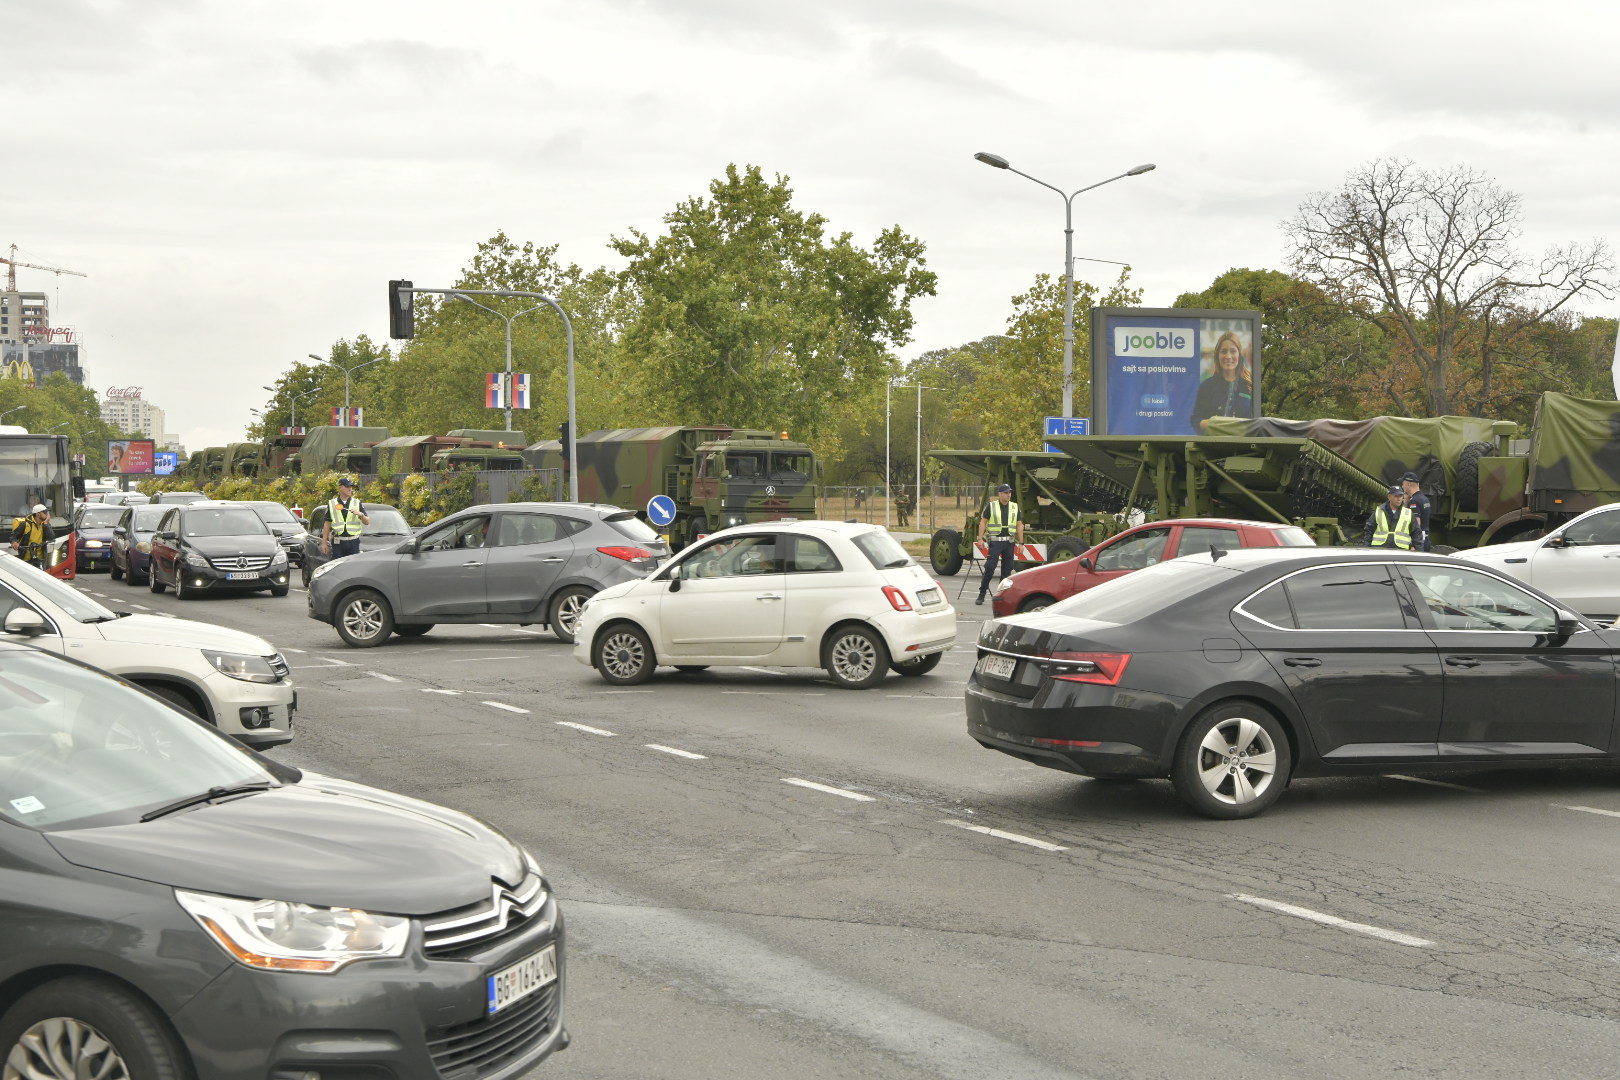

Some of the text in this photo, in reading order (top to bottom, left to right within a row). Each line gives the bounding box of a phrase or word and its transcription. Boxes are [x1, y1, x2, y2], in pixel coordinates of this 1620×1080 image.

[1123, 331, 1186, 352] jooble
[1122, 365, 1137, 374] sajt
[1147, 365, 1187, 374] poslovima
[1138, 410, 1153, 418] drugi
[1153, 410, 1174, 418] poslovi
[497, 973, 510, 1004] BG
